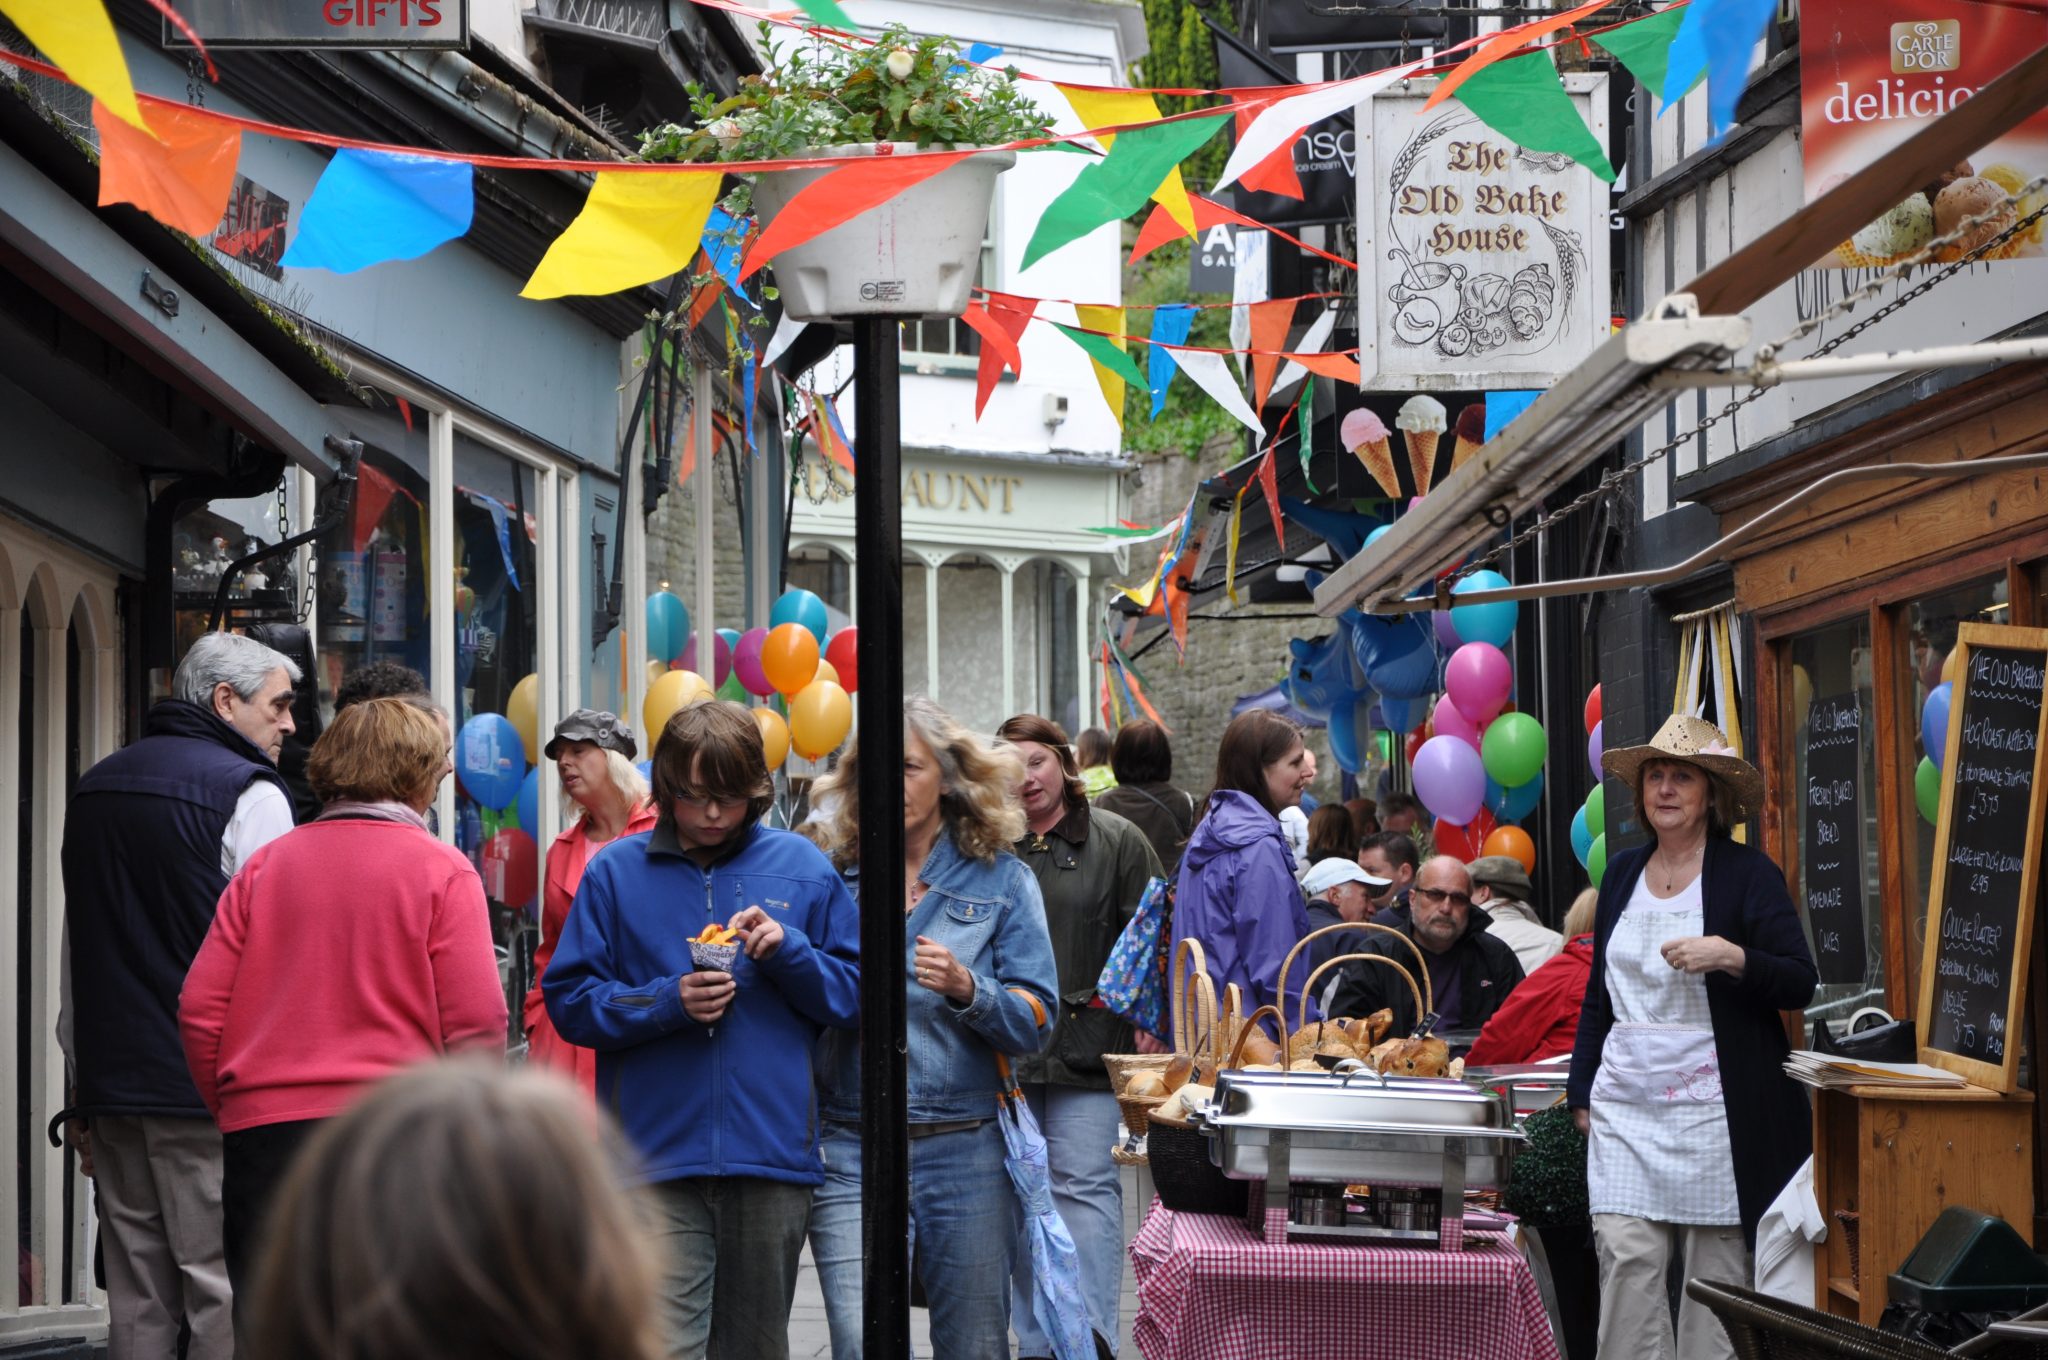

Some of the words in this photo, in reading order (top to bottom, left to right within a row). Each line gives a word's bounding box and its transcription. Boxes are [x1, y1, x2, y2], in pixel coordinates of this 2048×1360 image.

[322, 0, 442, 27] GIFTS
[1896, 33, 1954, 53] CARTE
[1903, 50, 1950, 69] D'OR
[1825, 76, 1985, 124] delicio
[1310, 160, 1342, 172] cream
[1447, 141, 1508, 175] The
[1399, 184, 1464, 216] Old
[1475, 184, 1568, 220] Bake
[1427, 222, 1530, 257] House
[1970, 649, 1991, 682] THE
[1990, 658, 2010, 687] OLD
[1943, 907, 1973, 942] QUICHE
